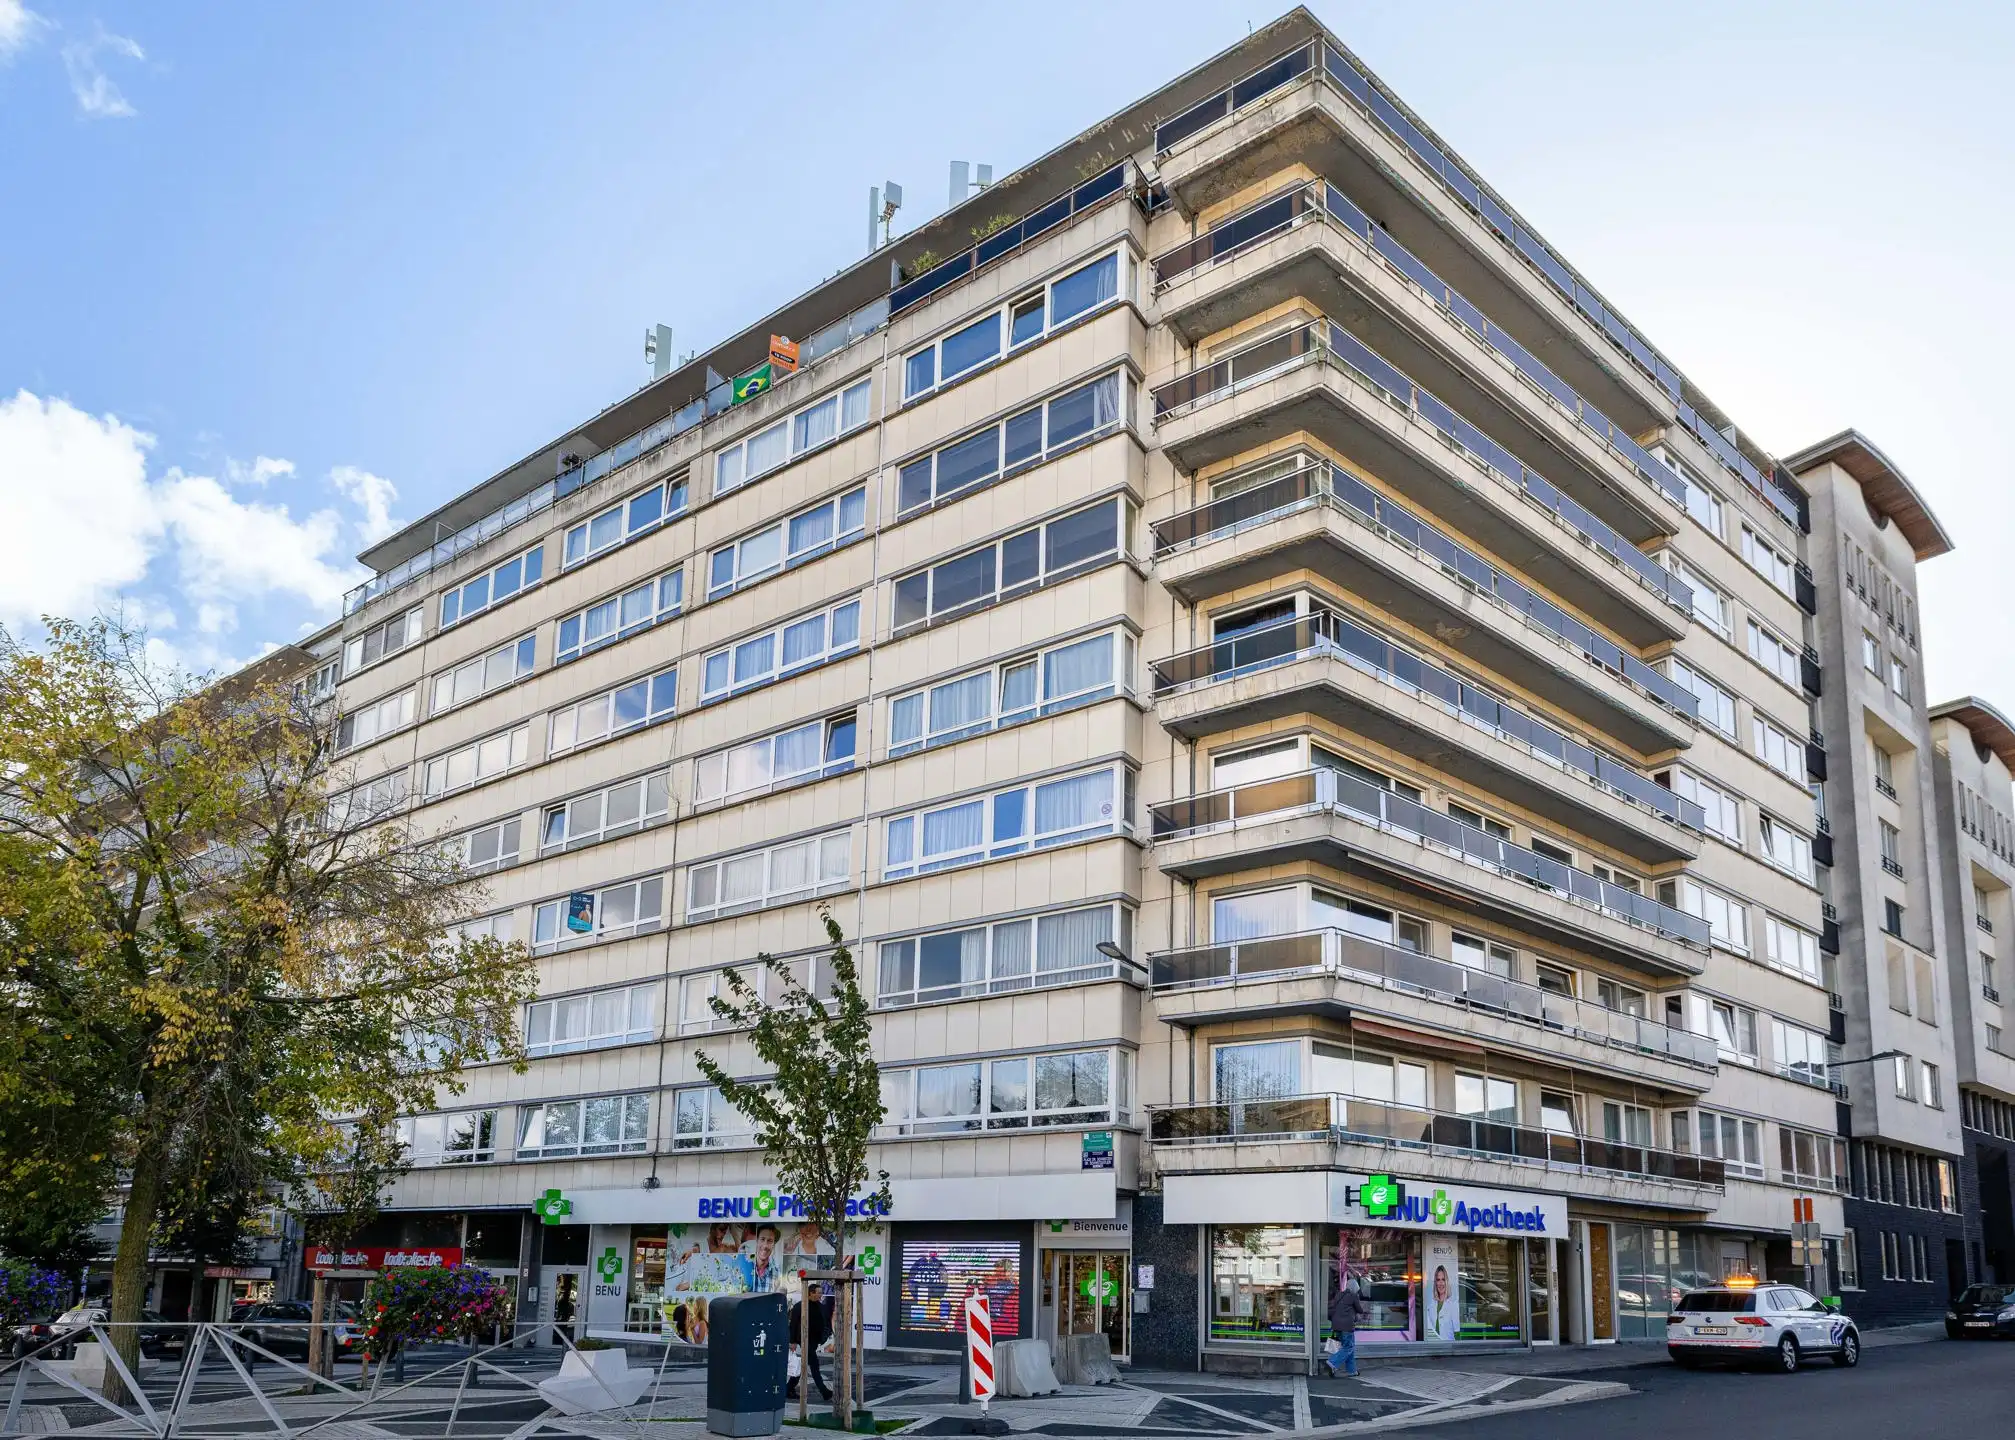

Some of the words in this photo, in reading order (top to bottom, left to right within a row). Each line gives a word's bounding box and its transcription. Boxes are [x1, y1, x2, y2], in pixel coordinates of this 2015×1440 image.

[698, 1197, 753, 1218] BENU
[1453, 1200, 1547, 1232] Apotheek
[1074, 1221, 1128, 1231] Bienvenue
[384, 1251, 443, 1266] Ladbrokes.be
[862, 1276, 881, 1286] ENU
[595, 1285, 621, 1297] BENU
